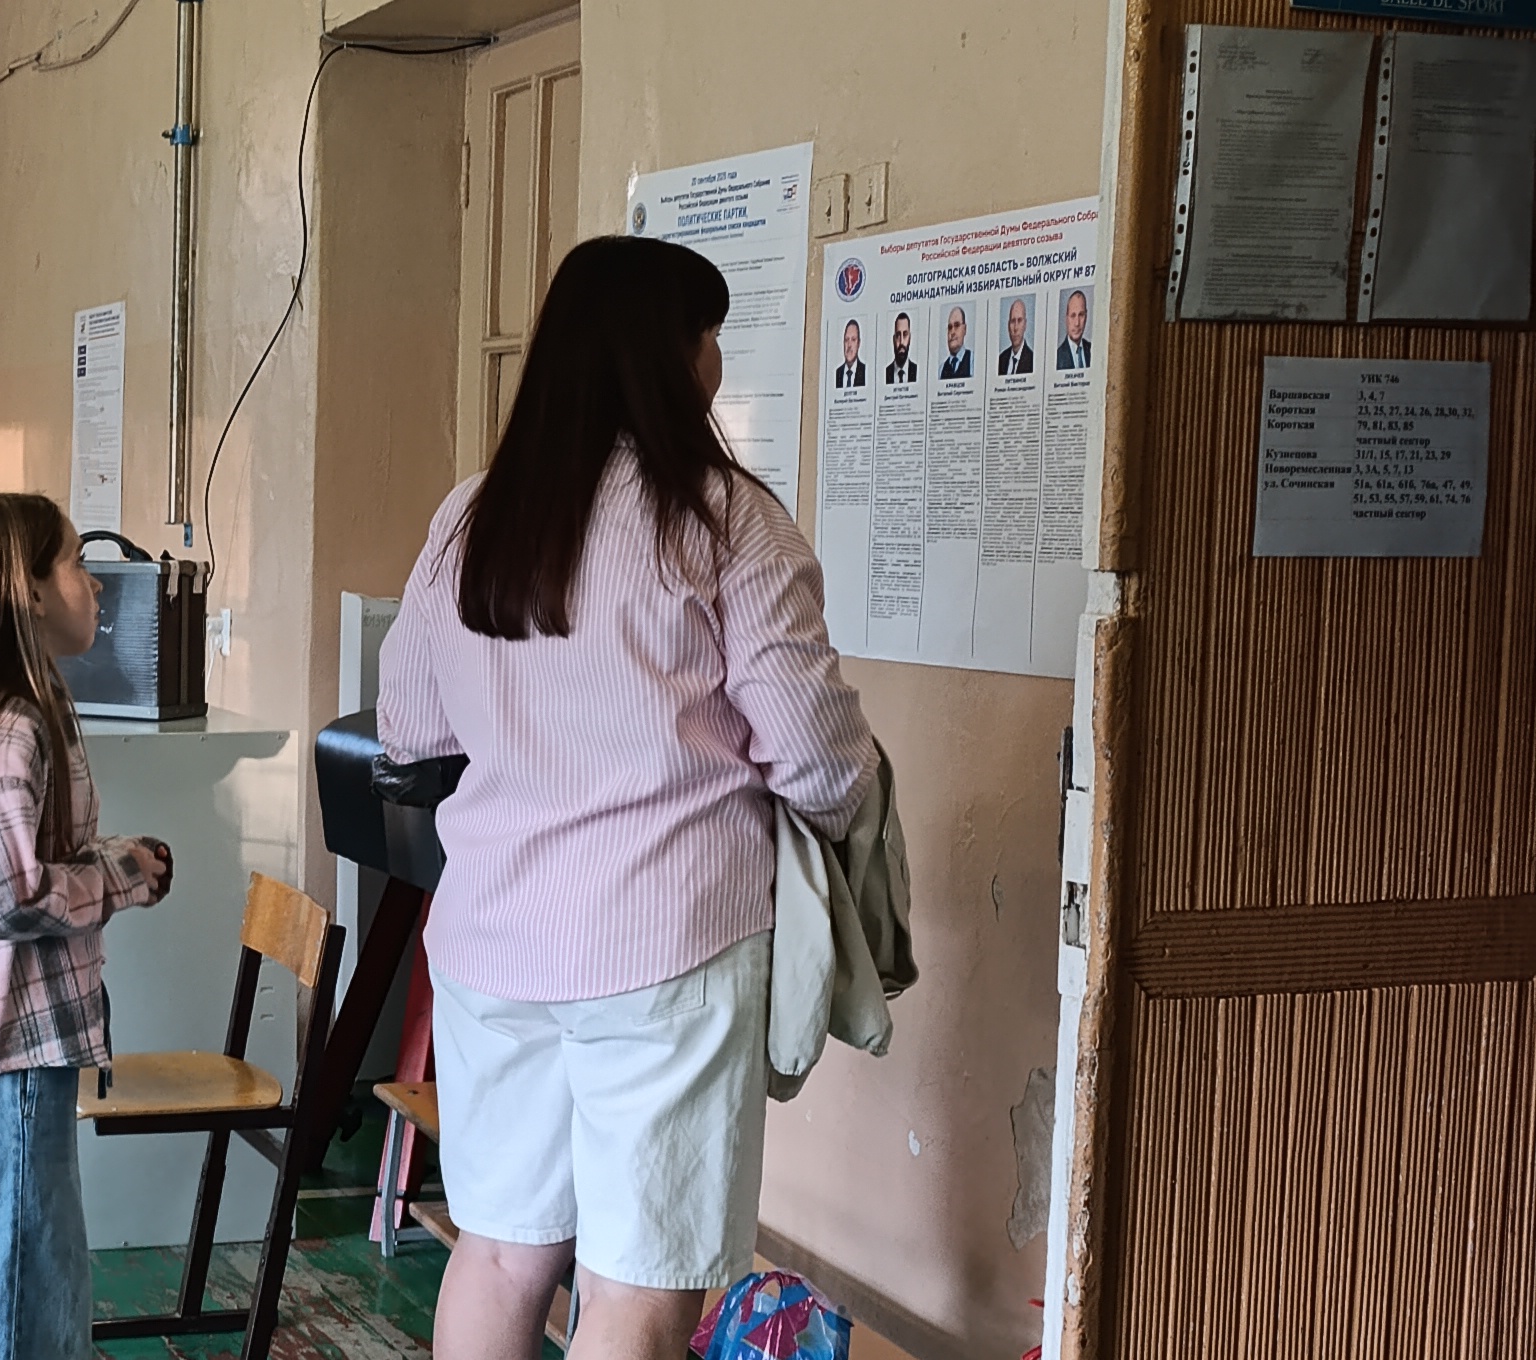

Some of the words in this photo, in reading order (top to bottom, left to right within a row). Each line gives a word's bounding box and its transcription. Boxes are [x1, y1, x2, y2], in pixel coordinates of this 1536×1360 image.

[678, 209, 722, 228] ПОЛИТИЧЕСКИЕ
[880, 244, 906, 255] Выборы
[906, 239, 940, 252] депутатов
[940, 224, 1000, 246] Государственной
[1000, 224, 1020, 236] Думы
[1022, 214, 1076, 231] Федерального
[921, 246, 960, 262] Российской
[961, 241, 1002, 256] Федерации
[1002, 236, 1036, 250] девятого
[1036, 232, 1063, 244] созыва
[906, 264, 976, 286] ВОЛГОГРАДСКАЯ
[977, 259, 1018, 276] ОБЛАСТЬ
[1026, 246, 1078, 268] ВОЛЖСКИЙ
[890, 280, 964, 304] ОДНОМАНДАТНЫЙ
[966, 270, 1042, 294] ИЗБИРАТЕЛЬНЫЙ
[1043, 268, 1072, 282] ОКРУГ
[1073, 266, 1084, 279] №
[1084, 264, 1096, 277] 87
[1361, 374, 1382, 384] УИК
[1384, 374, 1400, 384] 746
[1269, 389, 1330, 402] Варшавская
[1380, 391, 1386, 400] 7
[1268, 404, 1316, 416] Короткая
[1267, 419, 1314, 432] Короткая
[1403, 421, 1414, 431] 85
[1356, 436, 1397, 446] частный
[1399, 437, 1431, 448] сектор
[1266, 448, 1318, 461] Кузнецова
[1440, 450, 1452, 460] 29
[1265, 463, 1352, 476] Новоремесленная
[1404, 465, 1414, 474] 13
[1263, 480, 1278, 491] ул.
[1280, 478, 1335, 488] Сочинская
[1353, 508, 1394, 518] частный
[1395, 510, 1426, 521] сектор
